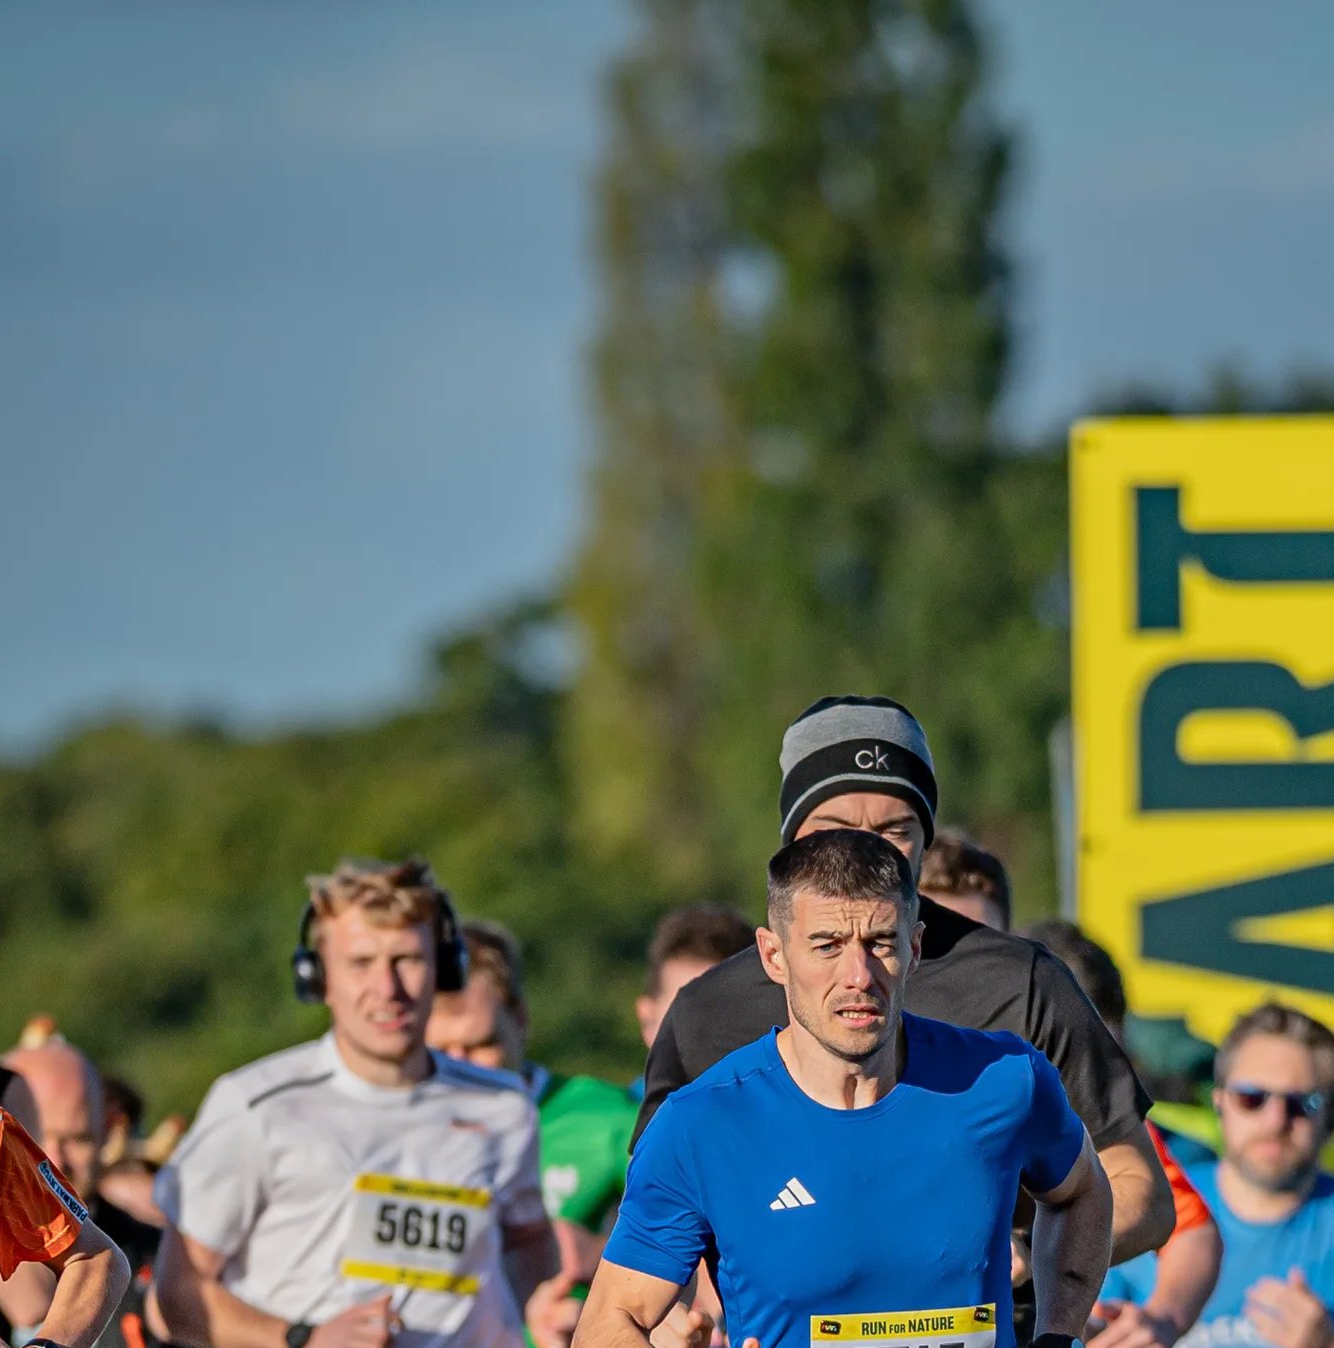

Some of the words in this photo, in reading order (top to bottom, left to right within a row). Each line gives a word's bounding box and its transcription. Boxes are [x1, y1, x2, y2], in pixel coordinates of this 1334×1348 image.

[854, 745, 889, 770] ck
[375, 1203, 467, 1254] 5619
[861, 1321, 887, 1336] RUN
[889, 1323, 906, 1334] FOR
[908, 1316, 955, 1333] NATURE
